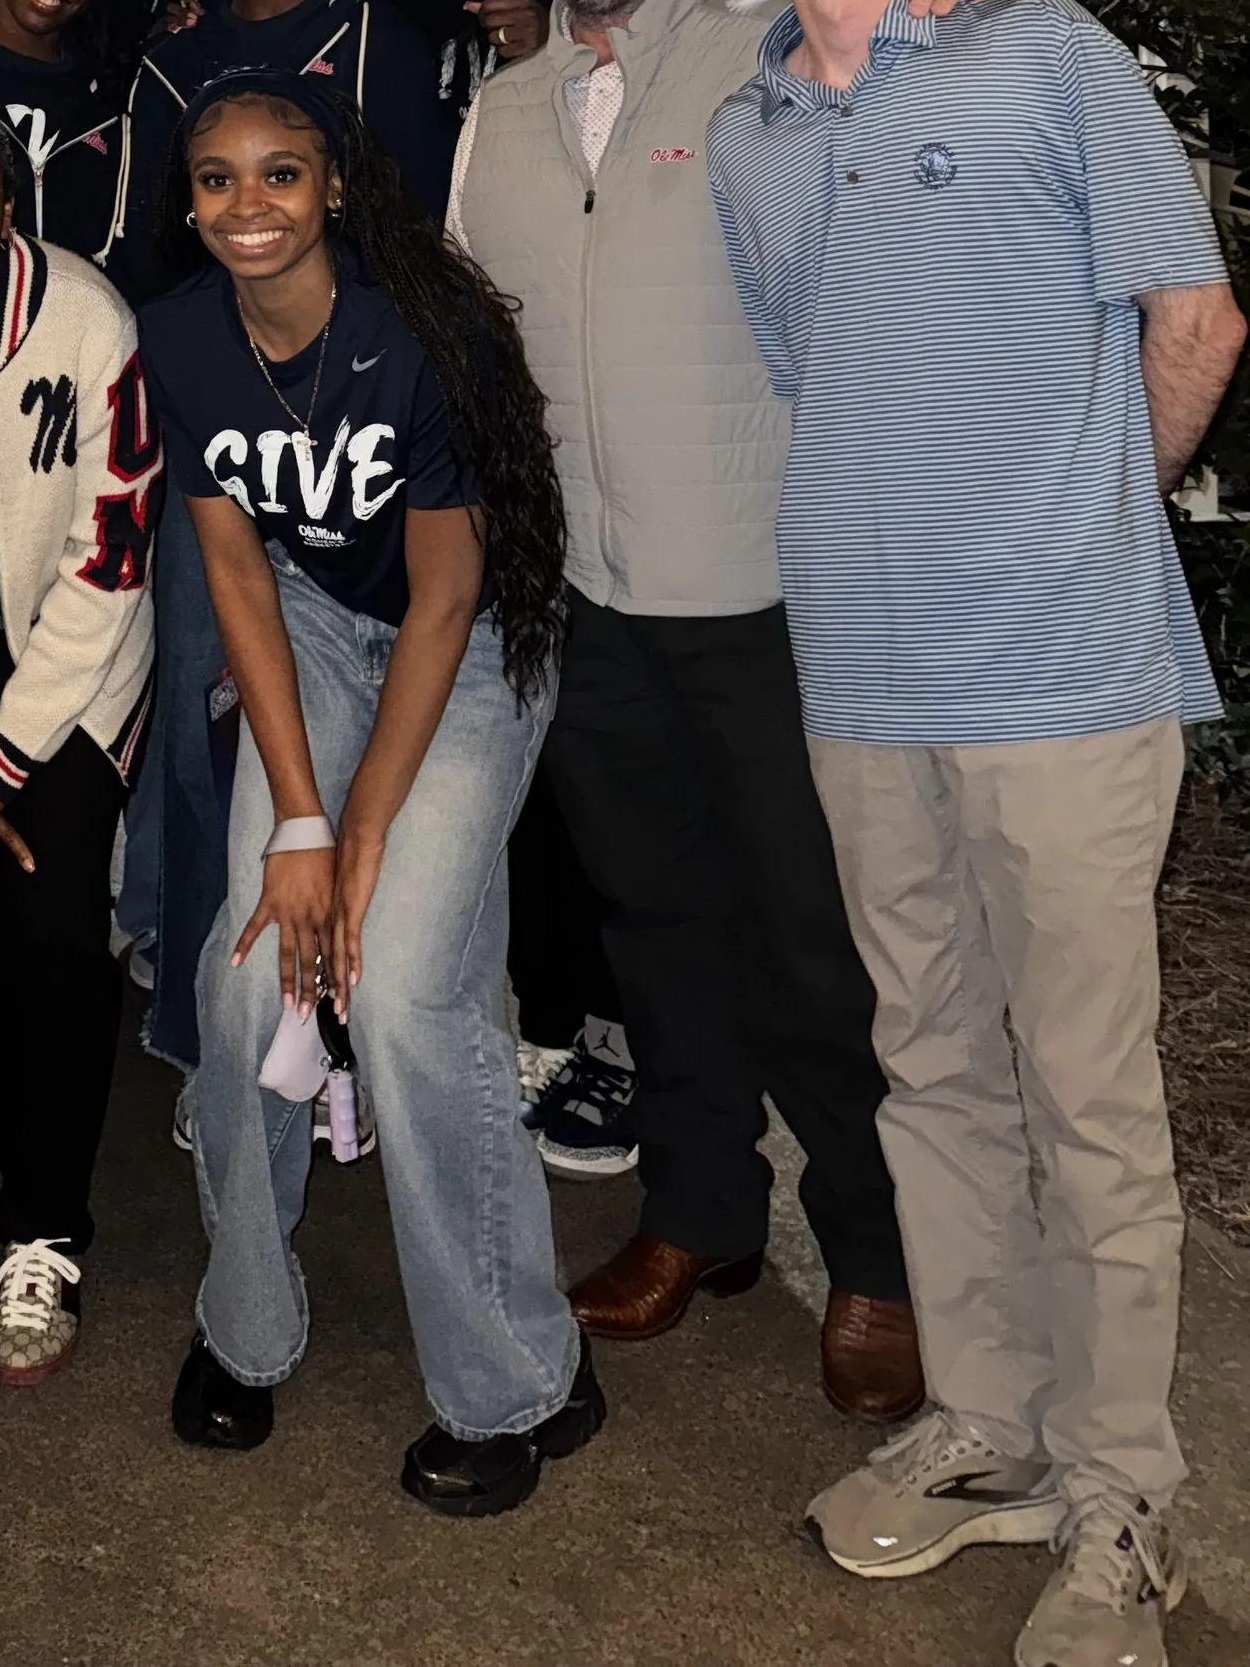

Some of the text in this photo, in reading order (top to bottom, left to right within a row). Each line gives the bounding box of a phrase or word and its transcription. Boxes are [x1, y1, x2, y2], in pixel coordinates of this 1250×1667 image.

[650, 146, 696, 163] Ole Miss
[311, 525, 346, 541] Miss
